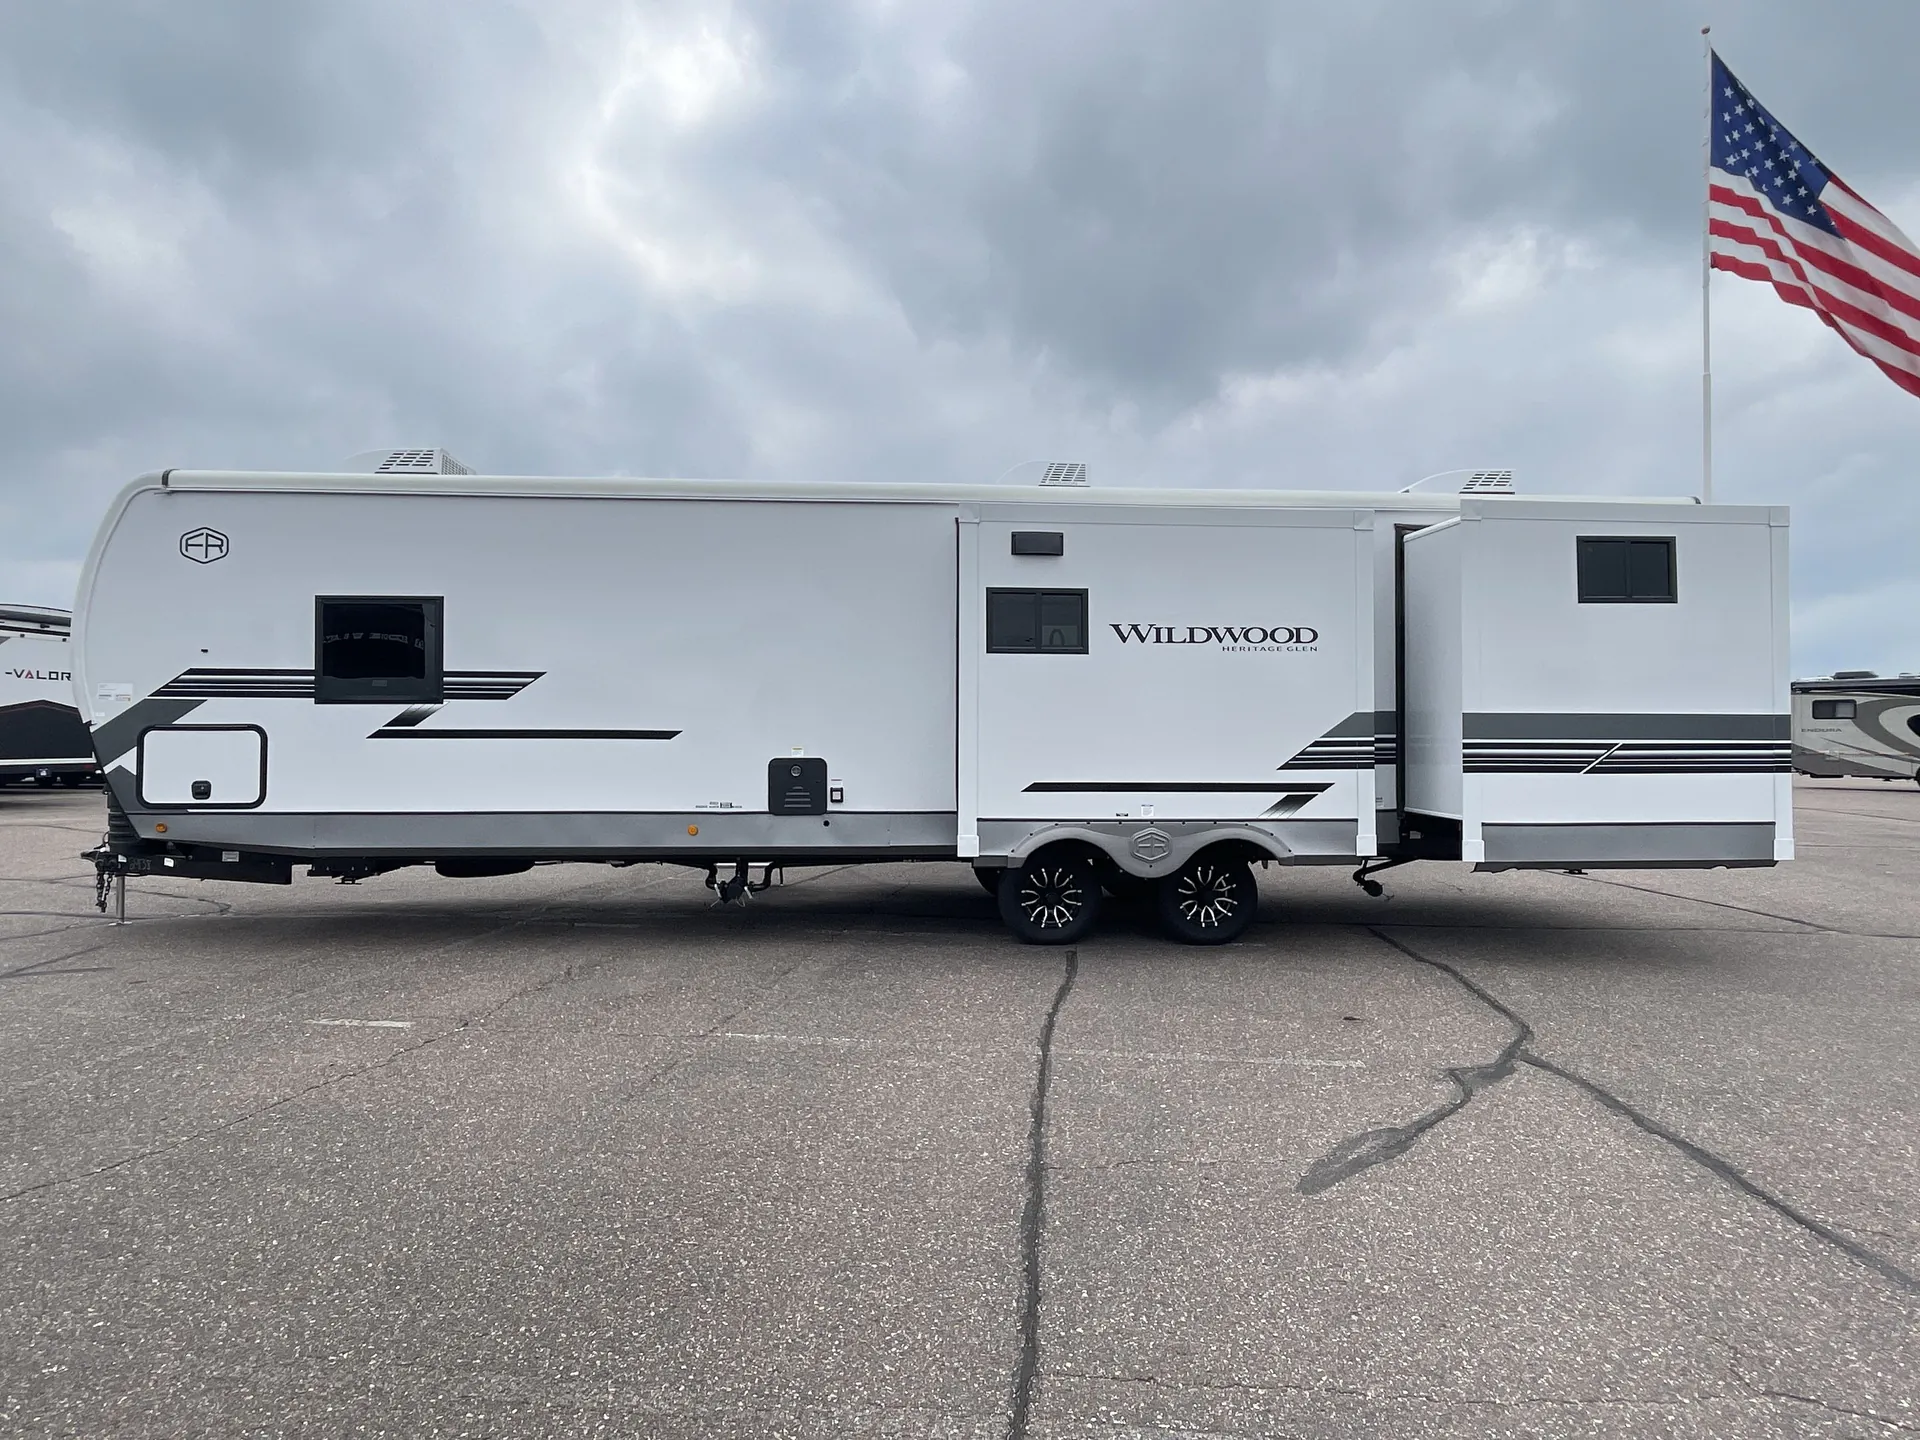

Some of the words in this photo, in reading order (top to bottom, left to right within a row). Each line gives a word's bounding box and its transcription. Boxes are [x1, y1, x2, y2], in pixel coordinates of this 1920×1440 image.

[1109, 623, 1319, 645] WILDWOOD
[1222, 645, 1283, 653] HERITAGE
[1286, 645, 1319, 653] GLEN
